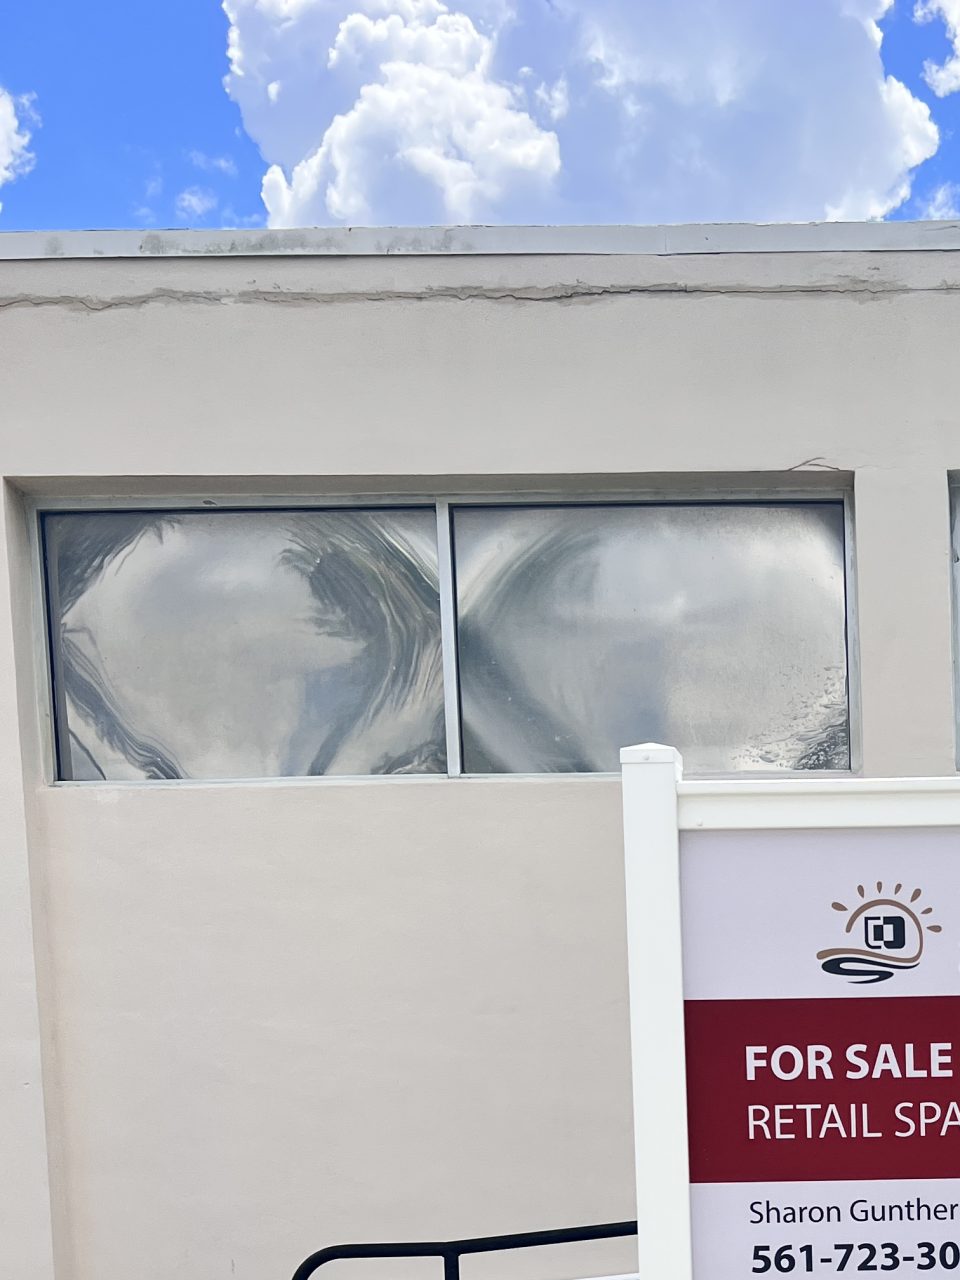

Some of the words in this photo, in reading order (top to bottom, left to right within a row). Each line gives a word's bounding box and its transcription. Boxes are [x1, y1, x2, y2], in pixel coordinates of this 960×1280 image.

[746, 1045, 833, 1080] FOR
[846, 1043, 953, 1079] SALE
[748, 1104, 882, 1139] RETAIL
[750, 1200, 840, 1224] Sharon
[850, 1198, 958, 1221] Gunther
